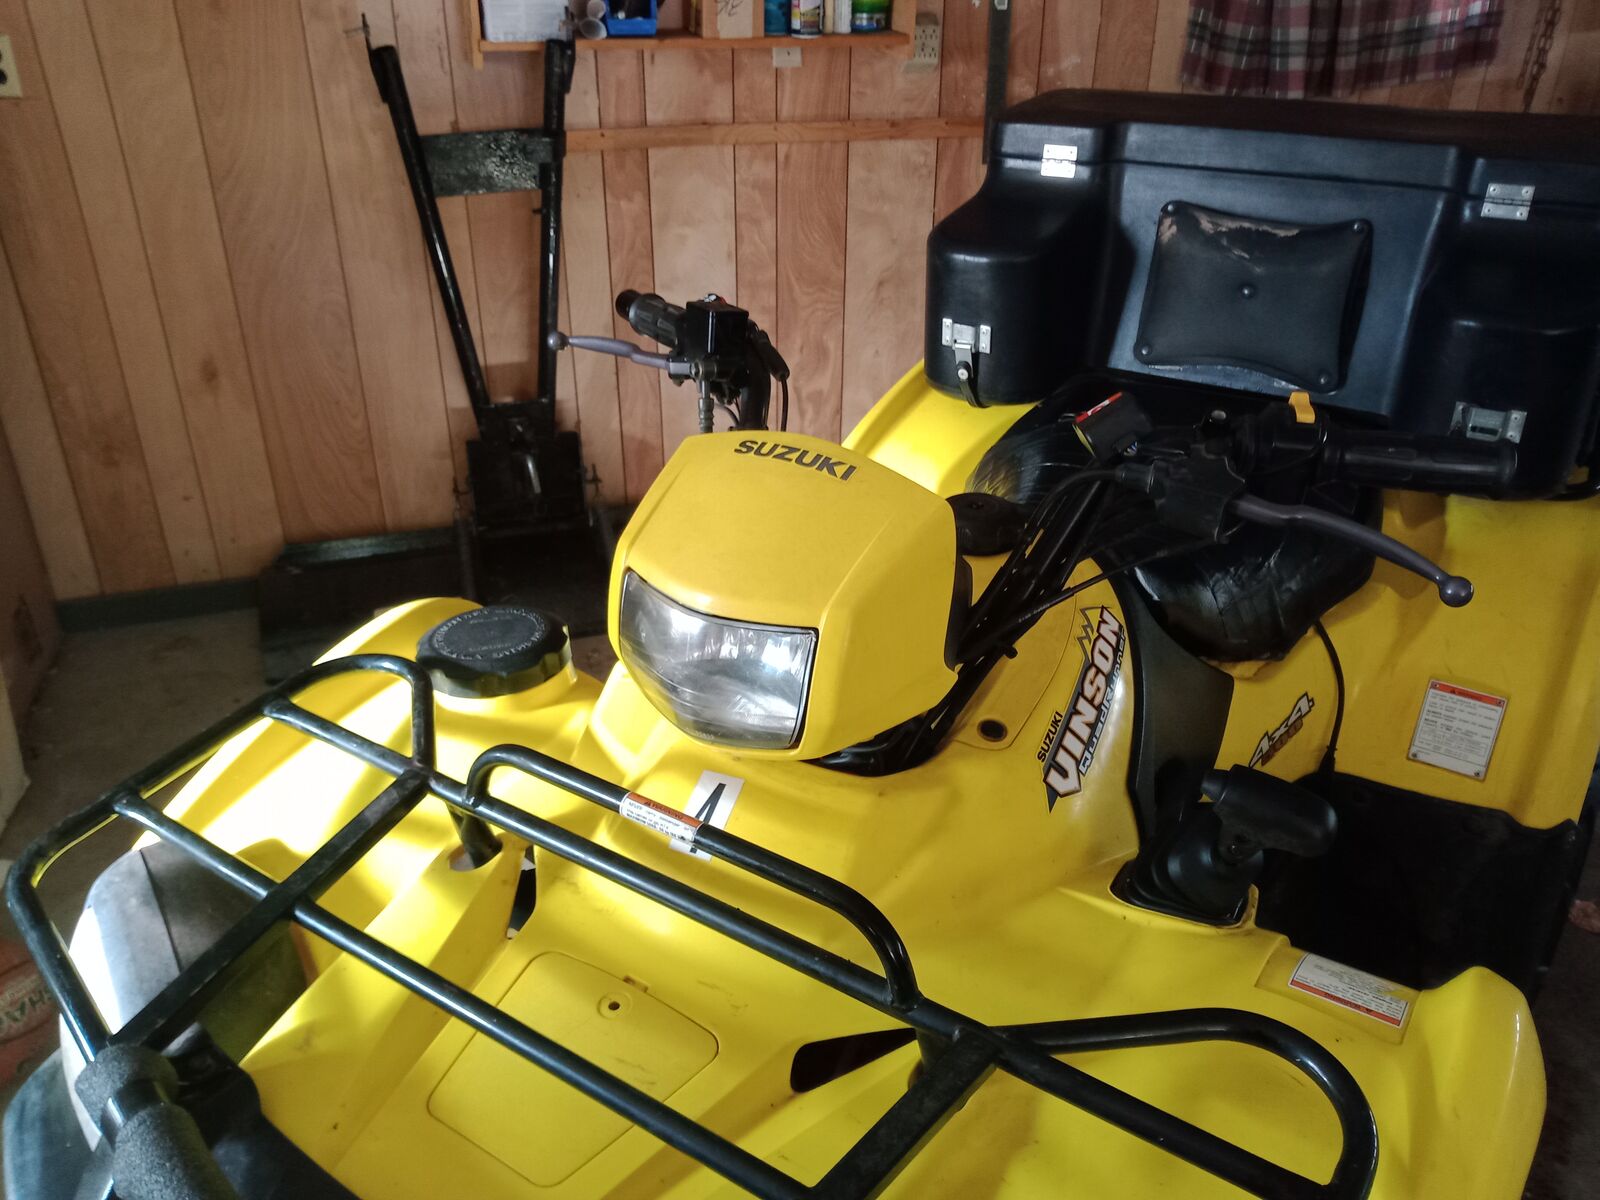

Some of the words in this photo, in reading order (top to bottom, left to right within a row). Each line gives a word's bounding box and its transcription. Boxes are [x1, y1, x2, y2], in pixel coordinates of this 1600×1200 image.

[734, 439, 857, 481] SUZUKI
[1043, 605, 1122, 798] VINSON
[1037, 711, 1063, 763] SUZUKI
